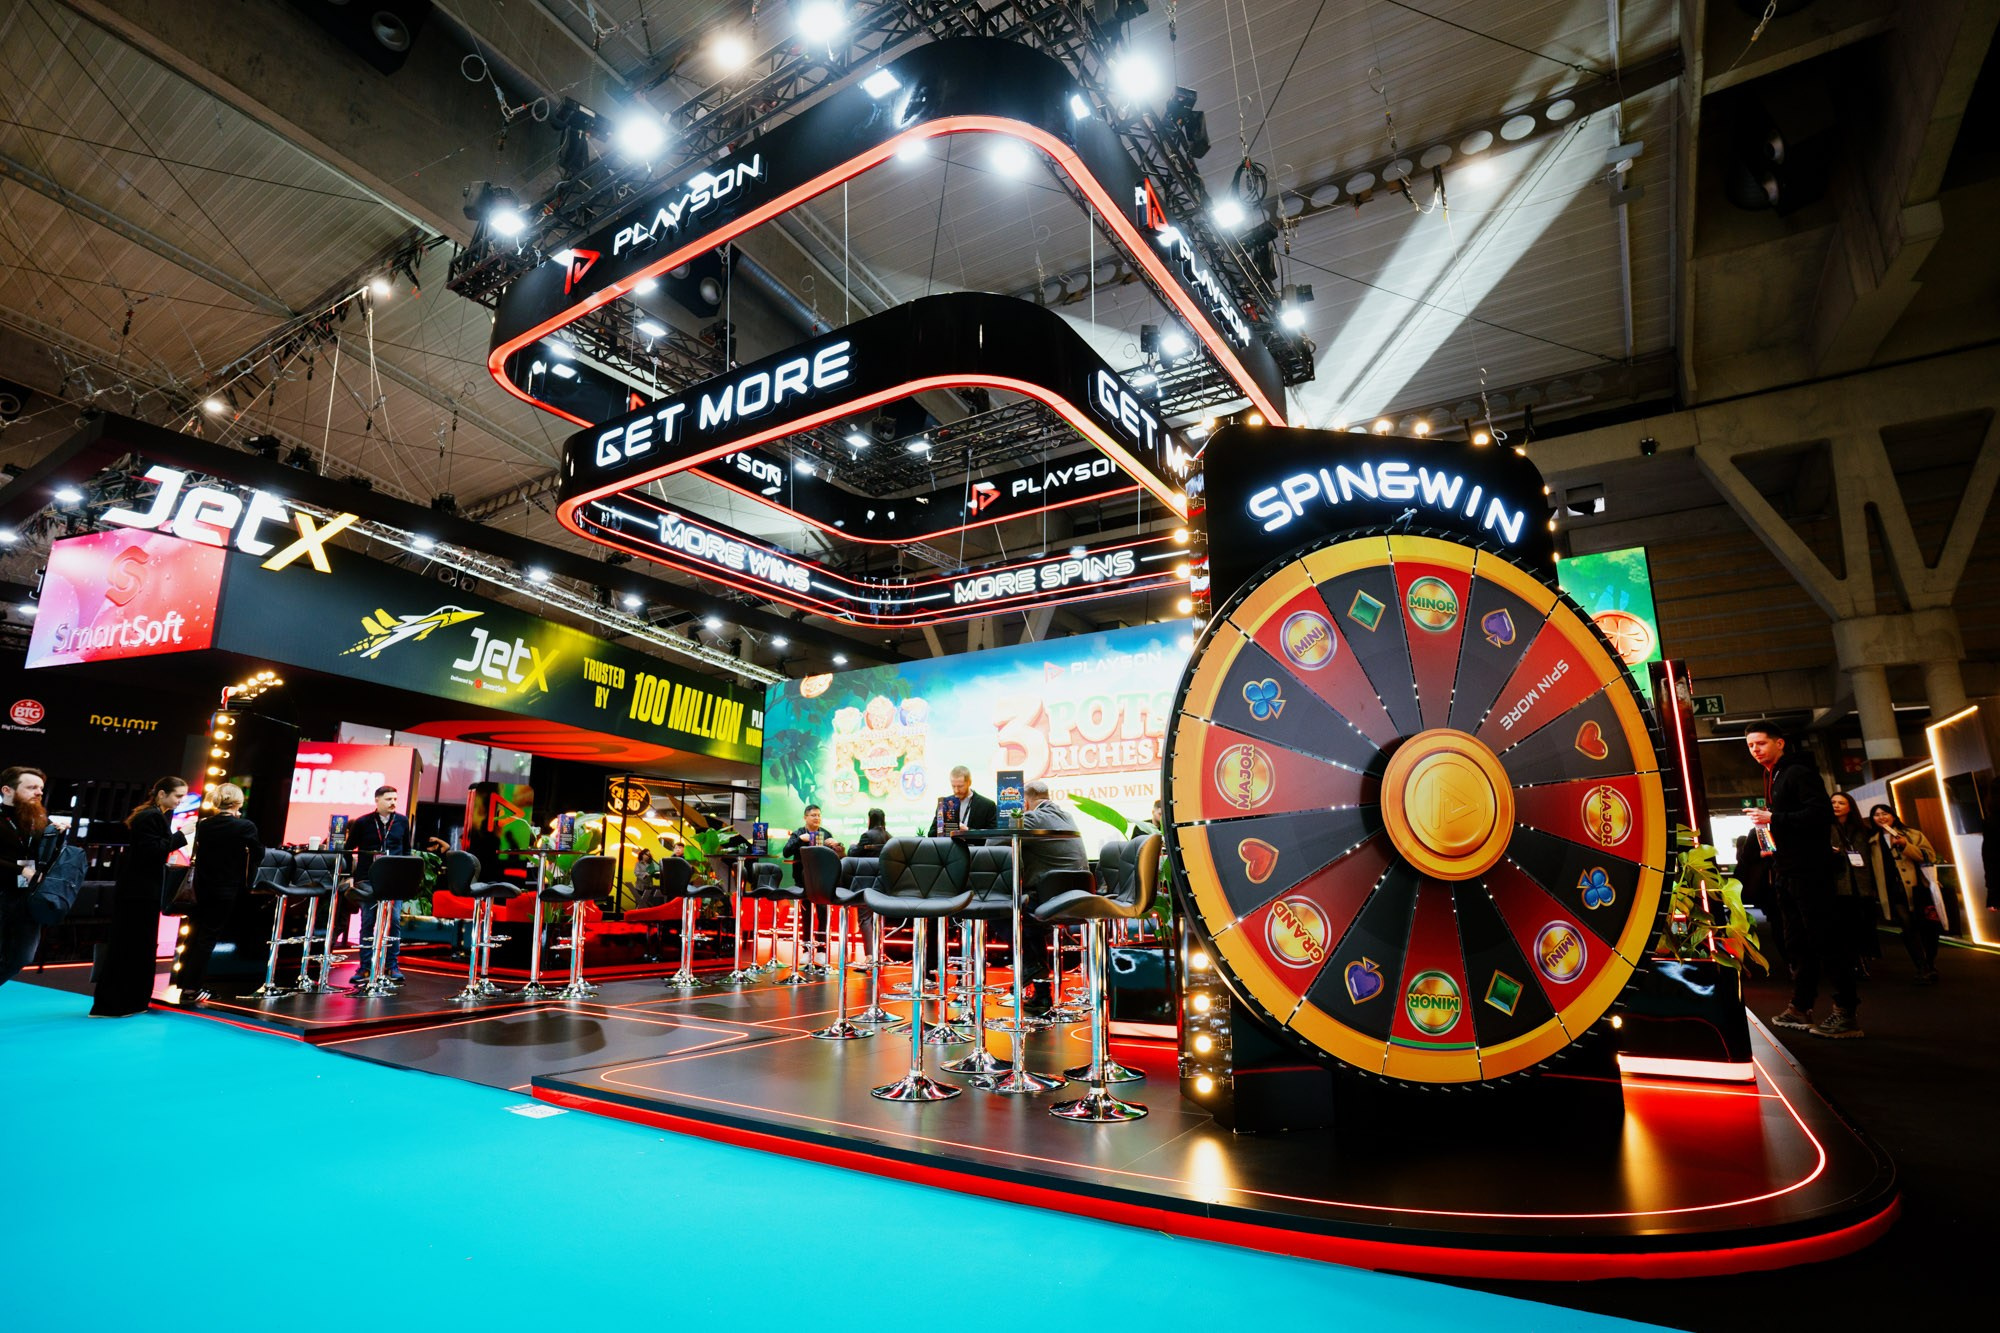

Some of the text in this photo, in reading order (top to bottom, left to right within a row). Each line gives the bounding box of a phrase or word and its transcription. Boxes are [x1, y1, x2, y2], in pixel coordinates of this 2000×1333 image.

[613, 154, 760, 256] PLAYSON
[596, 341, 850, 467] GET MORE
[1097, 370, 1158, 450] GET
[1249, 461, 1524, 543] SPIN&WIN
[660, 516, 811, 592] MORE WINS
[954, 549, 1136, 604] MORE SPINS
[53, 610, 185, 653] SmartSoft
[1408, 594, 1459, 614] MINOR
[452, 627, 560, 693] JetX
[1293, 625, 1325, 658] MINI
[583, 656, 626, 690] TRUSTED
[594, 686, 610, 709] BY
[1499, 658, 1570, 731] SPIN MORE
[14, 706, 41, 719] BTG
[629, 671, 744, 744] 100 MILLION
[1051, 738, 1154, 771] RICHES
[1236, 744, 1255, 810] MAJOR
[1088, 785, 1120, 799] AND
[1123, 783, 1155, 798] WIN
[1599, 784, 1614, 847] MAJOR
[1272, 900, 1326, 966] GRAND
[1547, 932, 1576, 970] MINI
[1408, 993, 1461, 1013] MINOR
